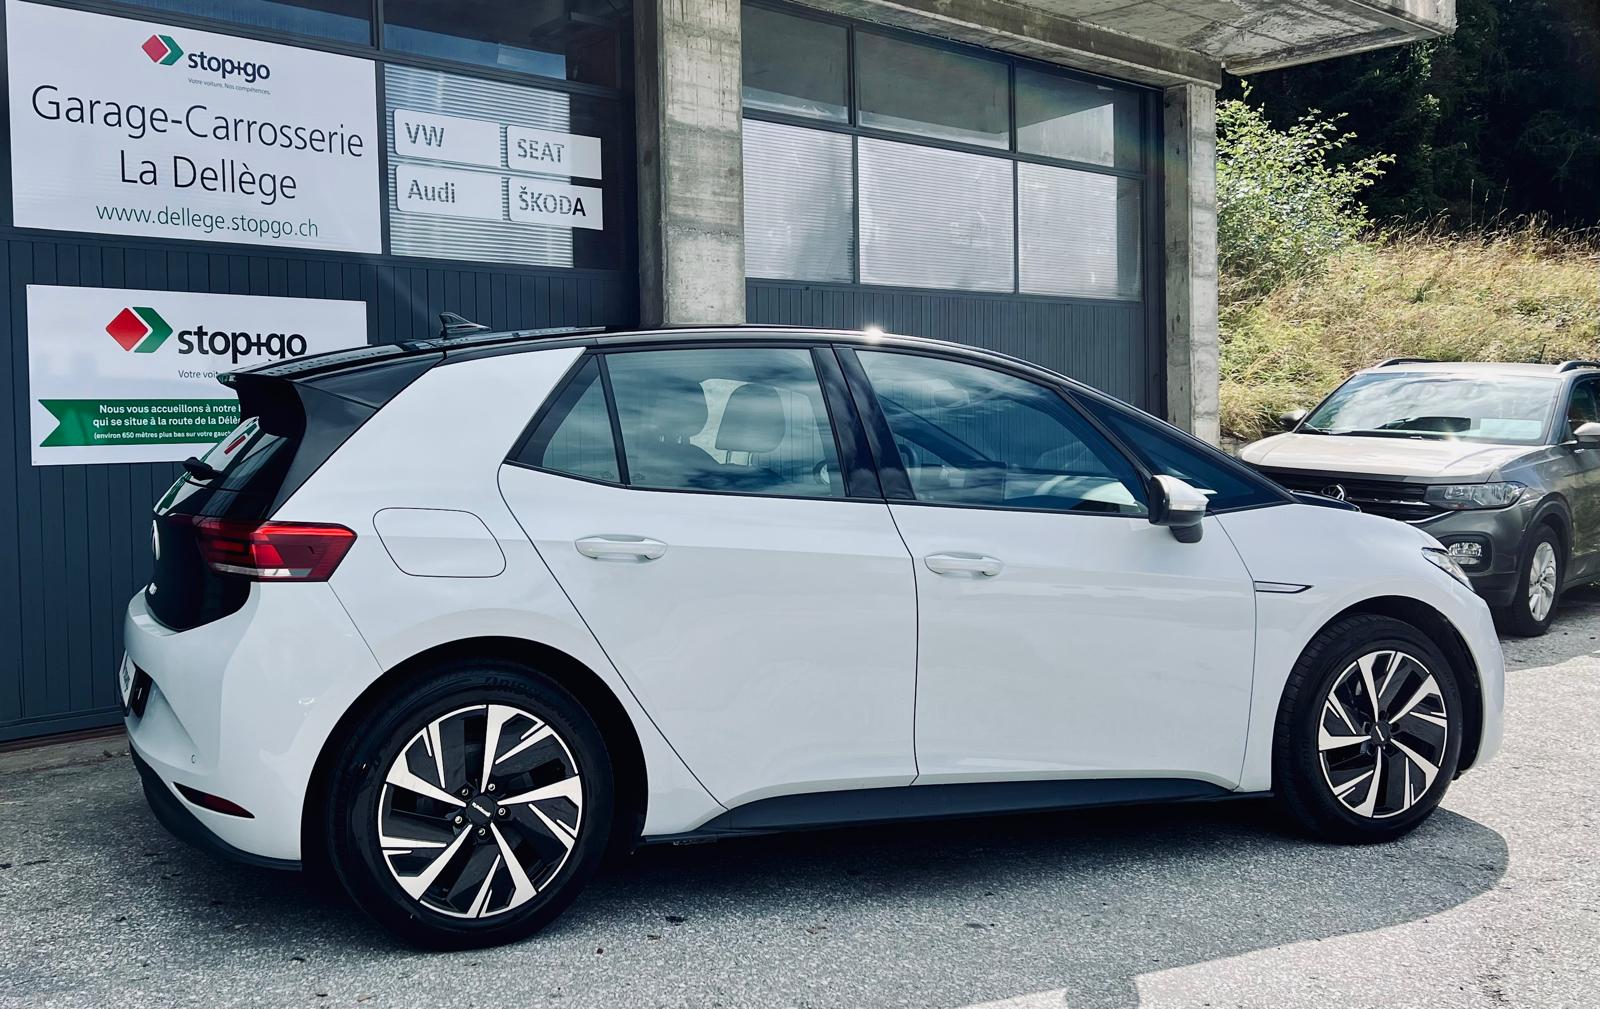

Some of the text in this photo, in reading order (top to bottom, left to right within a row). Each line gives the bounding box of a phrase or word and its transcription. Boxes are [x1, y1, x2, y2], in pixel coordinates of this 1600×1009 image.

[188, 51, 270, 83] stop+go
[32, 84, 364, 158] Garage-Carrosserie
[405, 122, 445, 148] VW
[517, 138, 565, 163] SEAT
[120, 150, 297, 206] La Dellège
[407, 179, 456, 204] Audi
[518, 185, 587, 217] ŠKODA
[96, 204, 319, 239] www.dellege.stopgo.ch
[178, 369, 201, 379] Votre
[99, 404, 125, 414] Nous
[126, 405, 149, 414] vous
[150, 404, 204, 413] accueillons
[205, 403, 211, 412] à
[212, 403, 237, 413] notre
[92, 416, 109, 428] qui
[110, 418, 122, 426] se
[123, 416, 149, 426] situe
[149, 415, 156, 426] à
[157, 415, 167, 426] la
[168, 416, 193, 426] route
[194, 416, 206, 425] de
[207, 415, 217, 425] la
[94, 431, 121, 440] (environ
[158, 430, 173, 439] plus
[196, 429, 213, 437] votre
